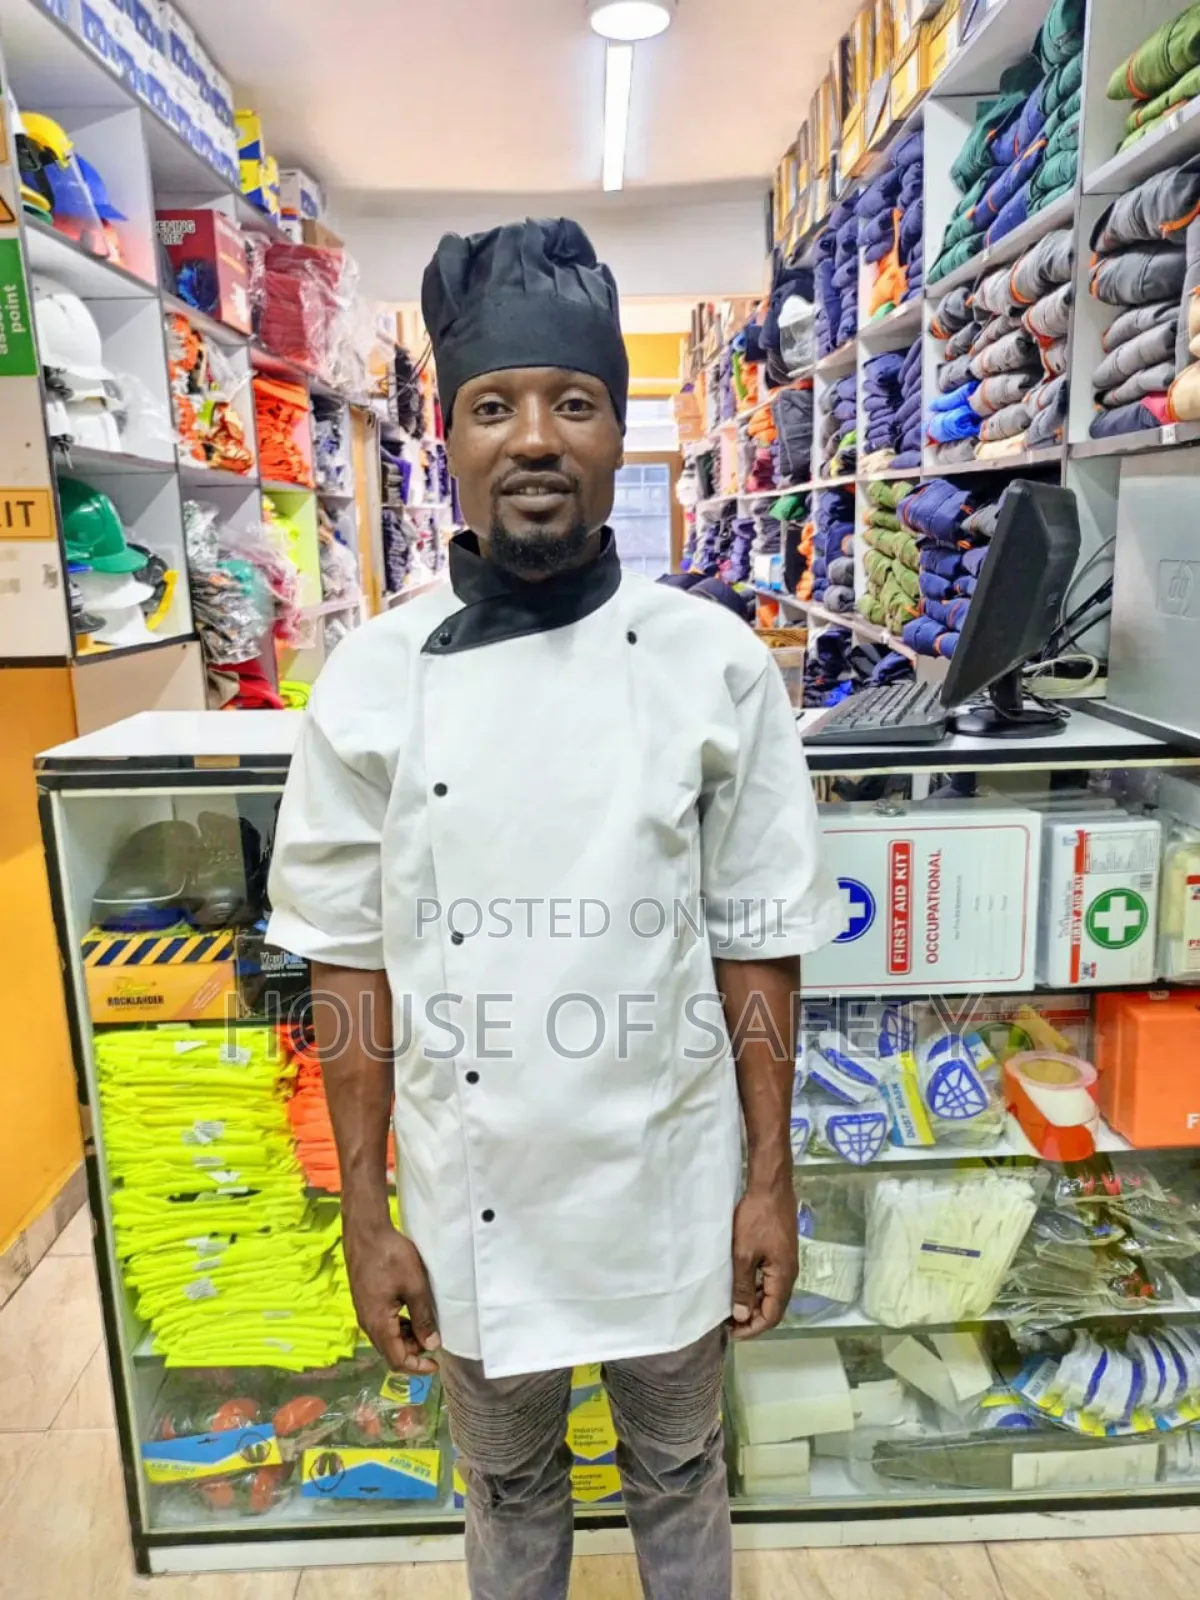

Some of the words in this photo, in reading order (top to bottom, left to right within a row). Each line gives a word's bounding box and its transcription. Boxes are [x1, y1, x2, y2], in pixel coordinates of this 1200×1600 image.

[4, 284, 26, 333] point
[0, 500, 36, 528] IT
[895, 852, 908, 880] KIT
[894, 884, 908, 912] AID
[925, 849, 942, 964] OCCUPATIONAL
[893, 917, 907, 964] FIRST
[890, 1083, 905, 1109] MASK
[901, 1115, 916, 1139] DUST
